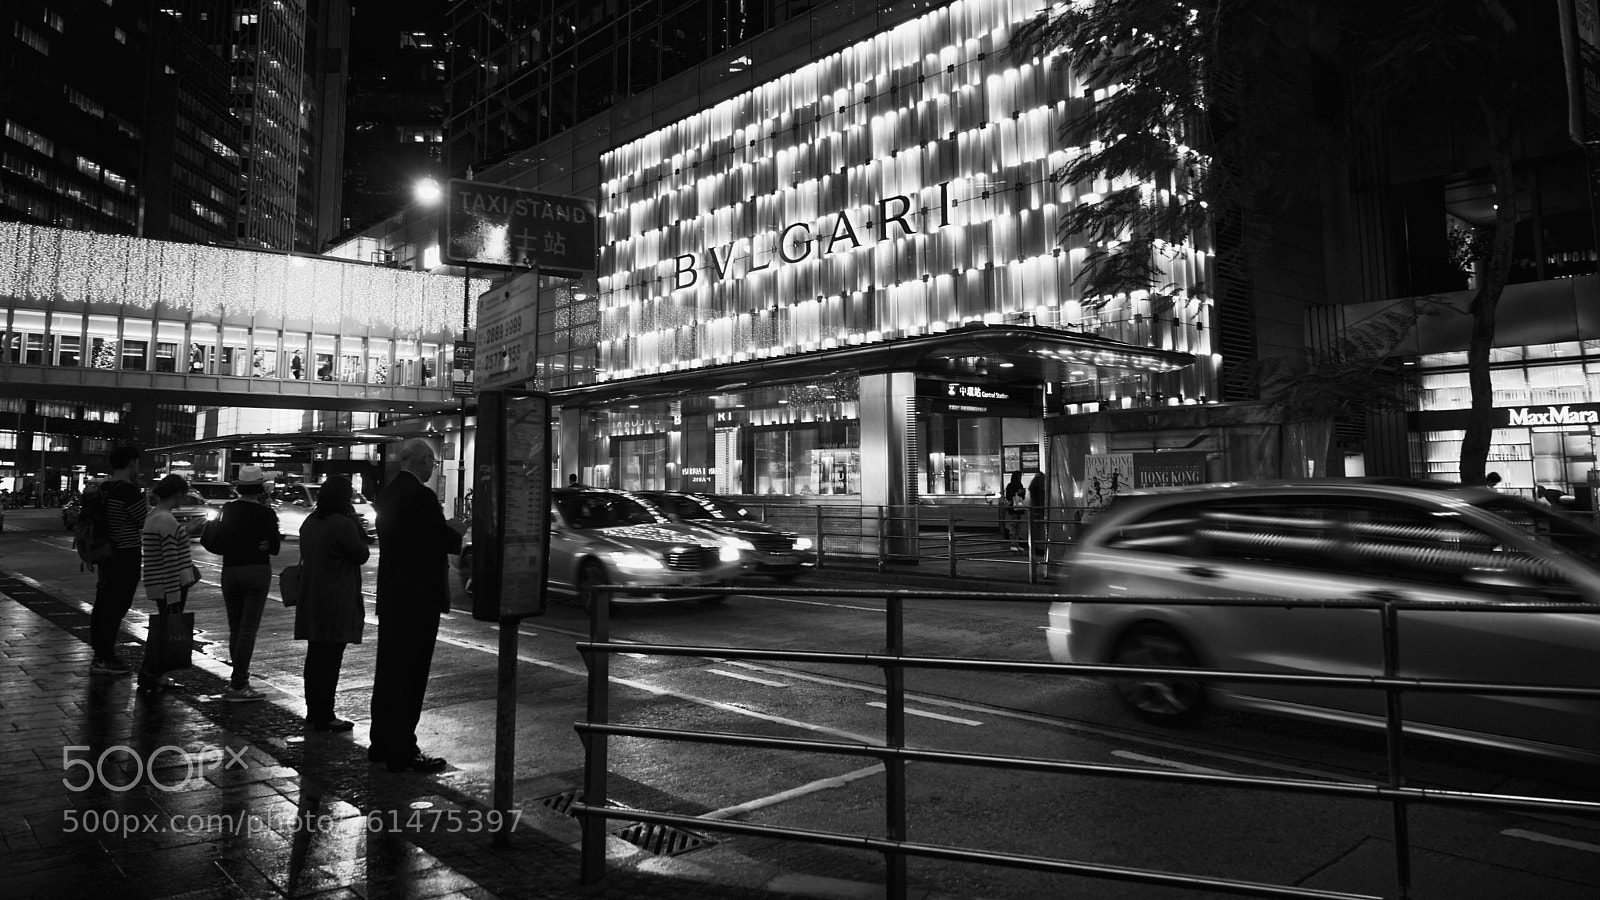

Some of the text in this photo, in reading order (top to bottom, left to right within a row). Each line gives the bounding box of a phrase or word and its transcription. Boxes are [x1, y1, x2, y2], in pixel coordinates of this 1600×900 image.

[459, 191, 586, 224] TAXI STAND
[513, 227, 567, 257] 士站
[674, 181, 951, 290] BVLGARI
[1508, 406, 1599, 426] MaxMara
[1110, 456, 1133, 466] KONG
[1140, 470, 1199, 483] HONG KONG
